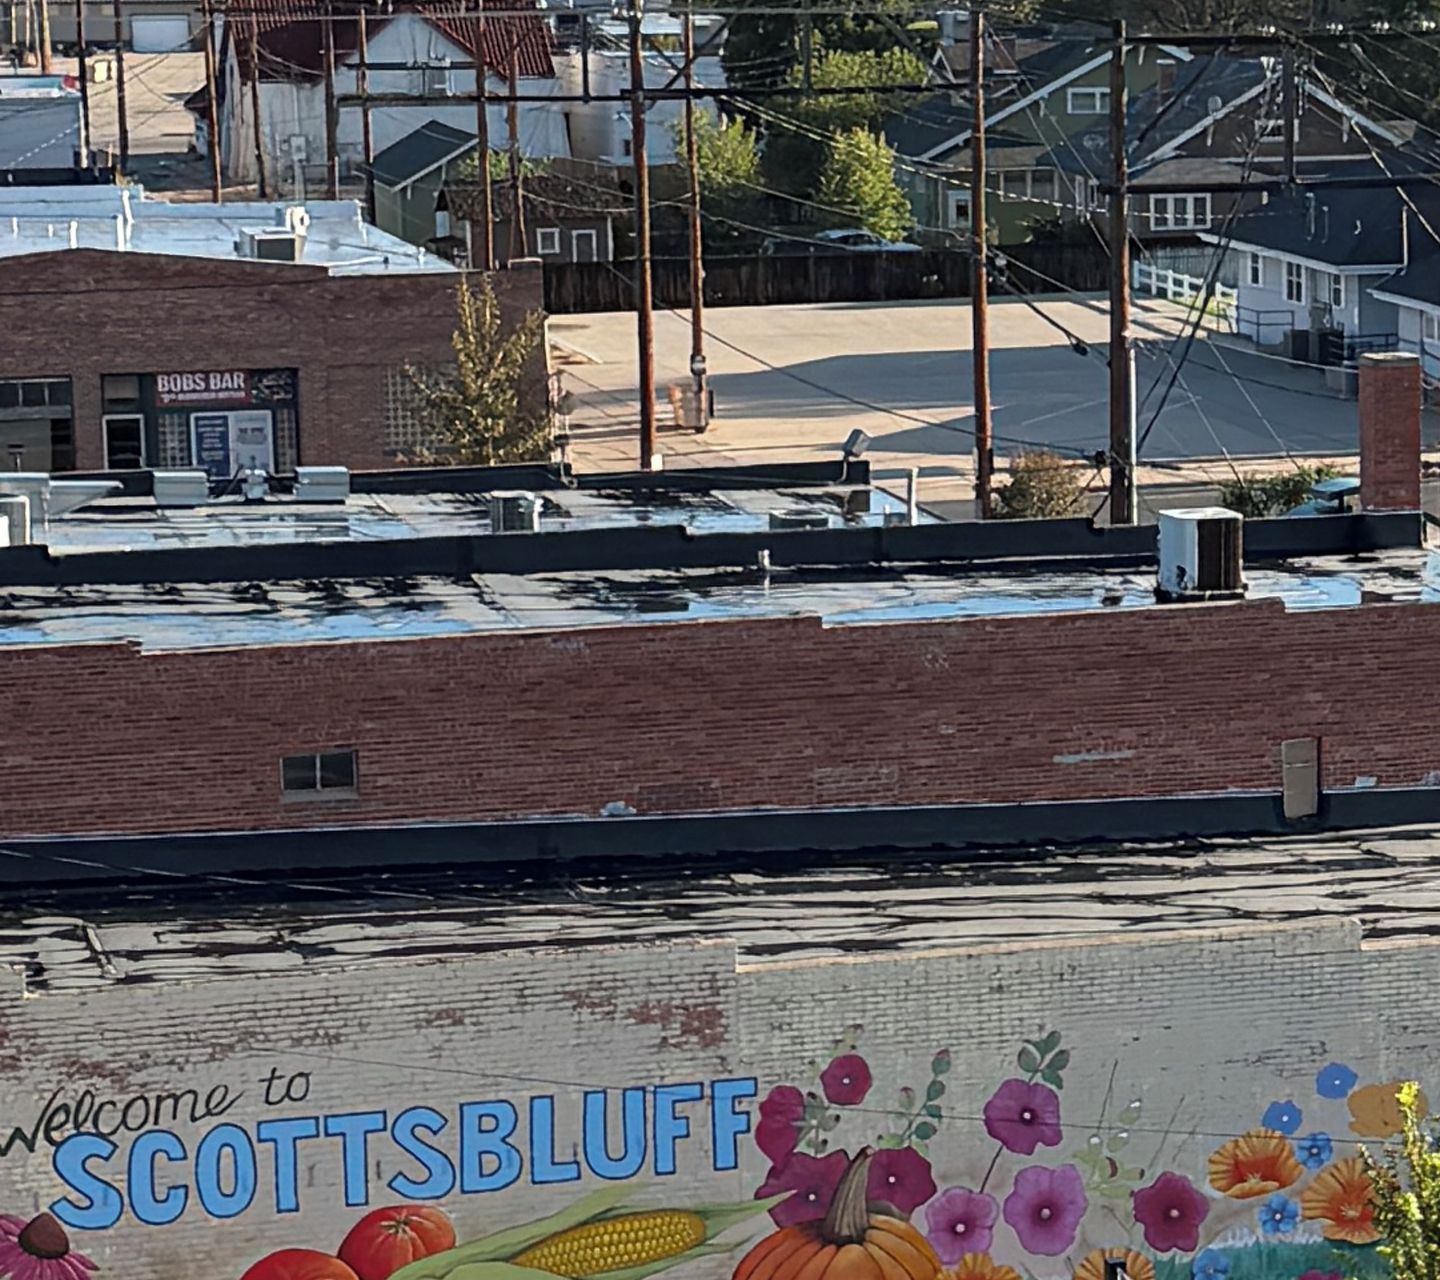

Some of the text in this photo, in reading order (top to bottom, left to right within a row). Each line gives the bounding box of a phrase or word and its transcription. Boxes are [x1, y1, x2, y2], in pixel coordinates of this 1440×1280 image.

[157, 373, 206, 392] BOBS
[209, 371, 245, 390] BAR
[0, 1066, 312, 1158] Welcome to
[49, 1076, 759, 1231] SCOTTSBLUFF
